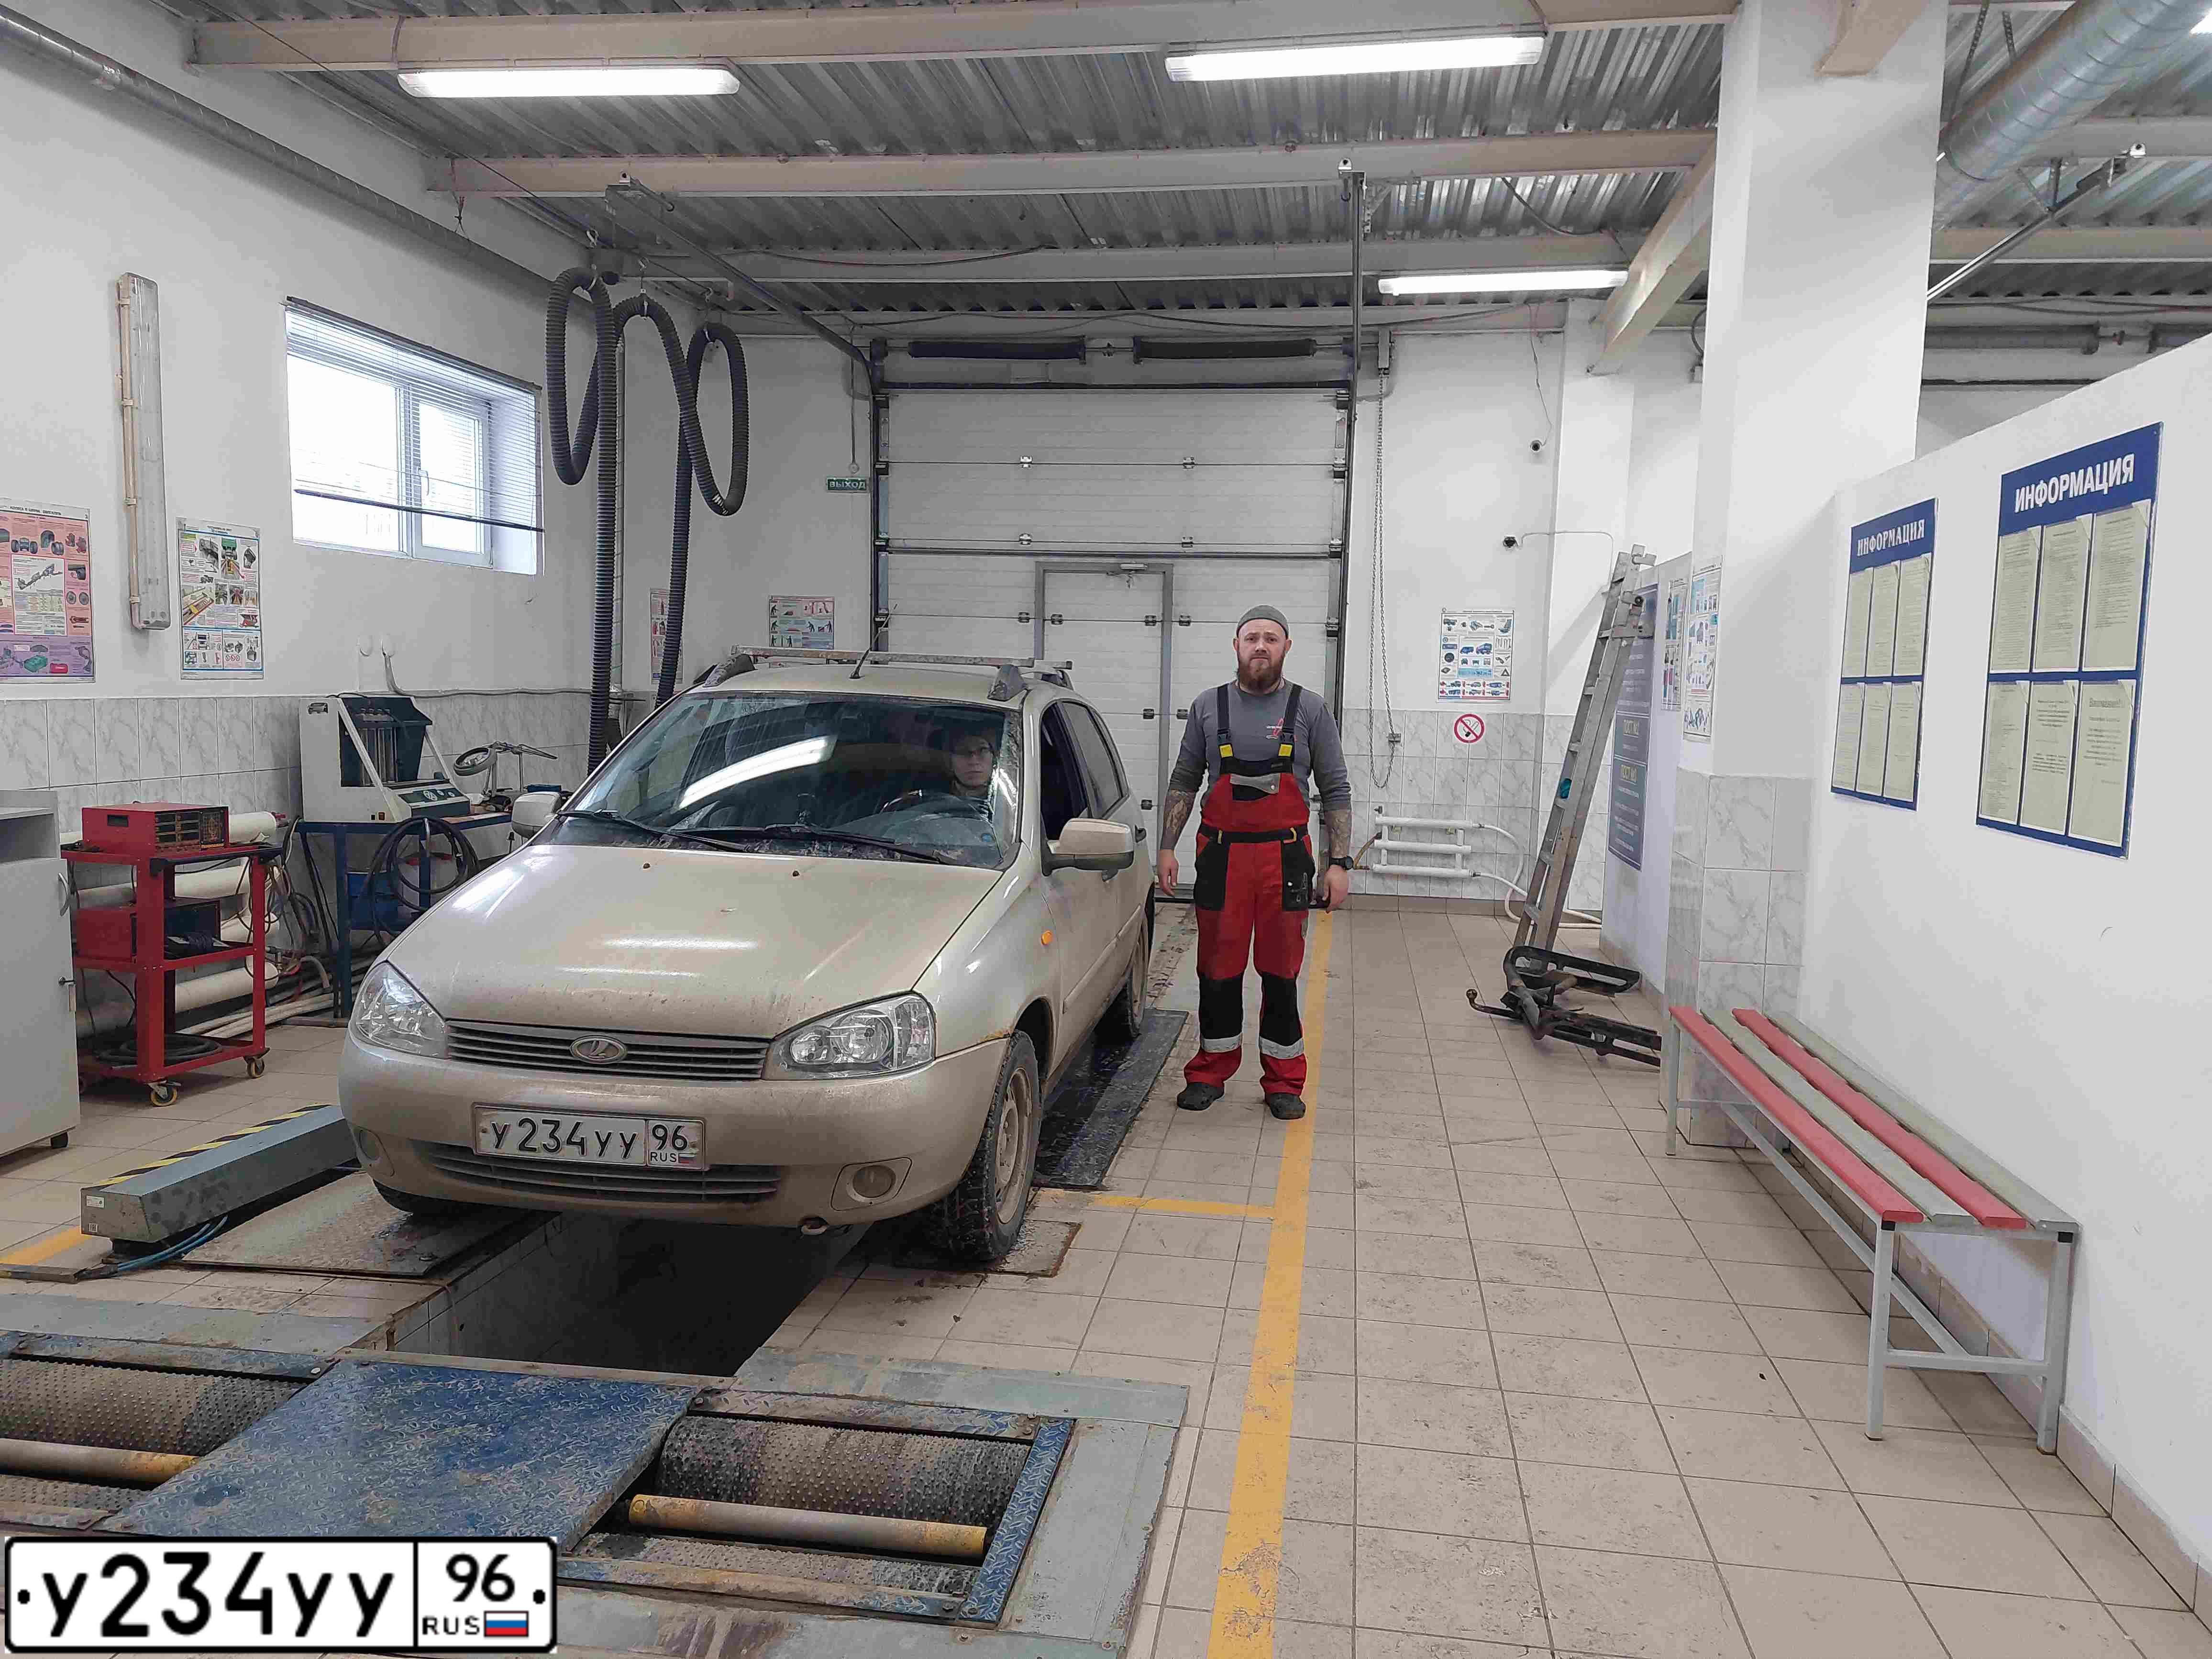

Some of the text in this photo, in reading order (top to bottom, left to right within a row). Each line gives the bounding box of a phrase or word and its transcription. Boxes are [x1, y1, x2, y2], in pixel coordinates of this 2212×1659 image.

[830, 481, 866, 490] ВЫХОД
[2014, 453, 2135, 513] ИНФОРМАЦИЯ
[1857, 519, 1925, 556] ИНФОРМАЦИЯ
[652, 1124, 688, 1151] 96
[650, 1152, 677, 1162] RUS
